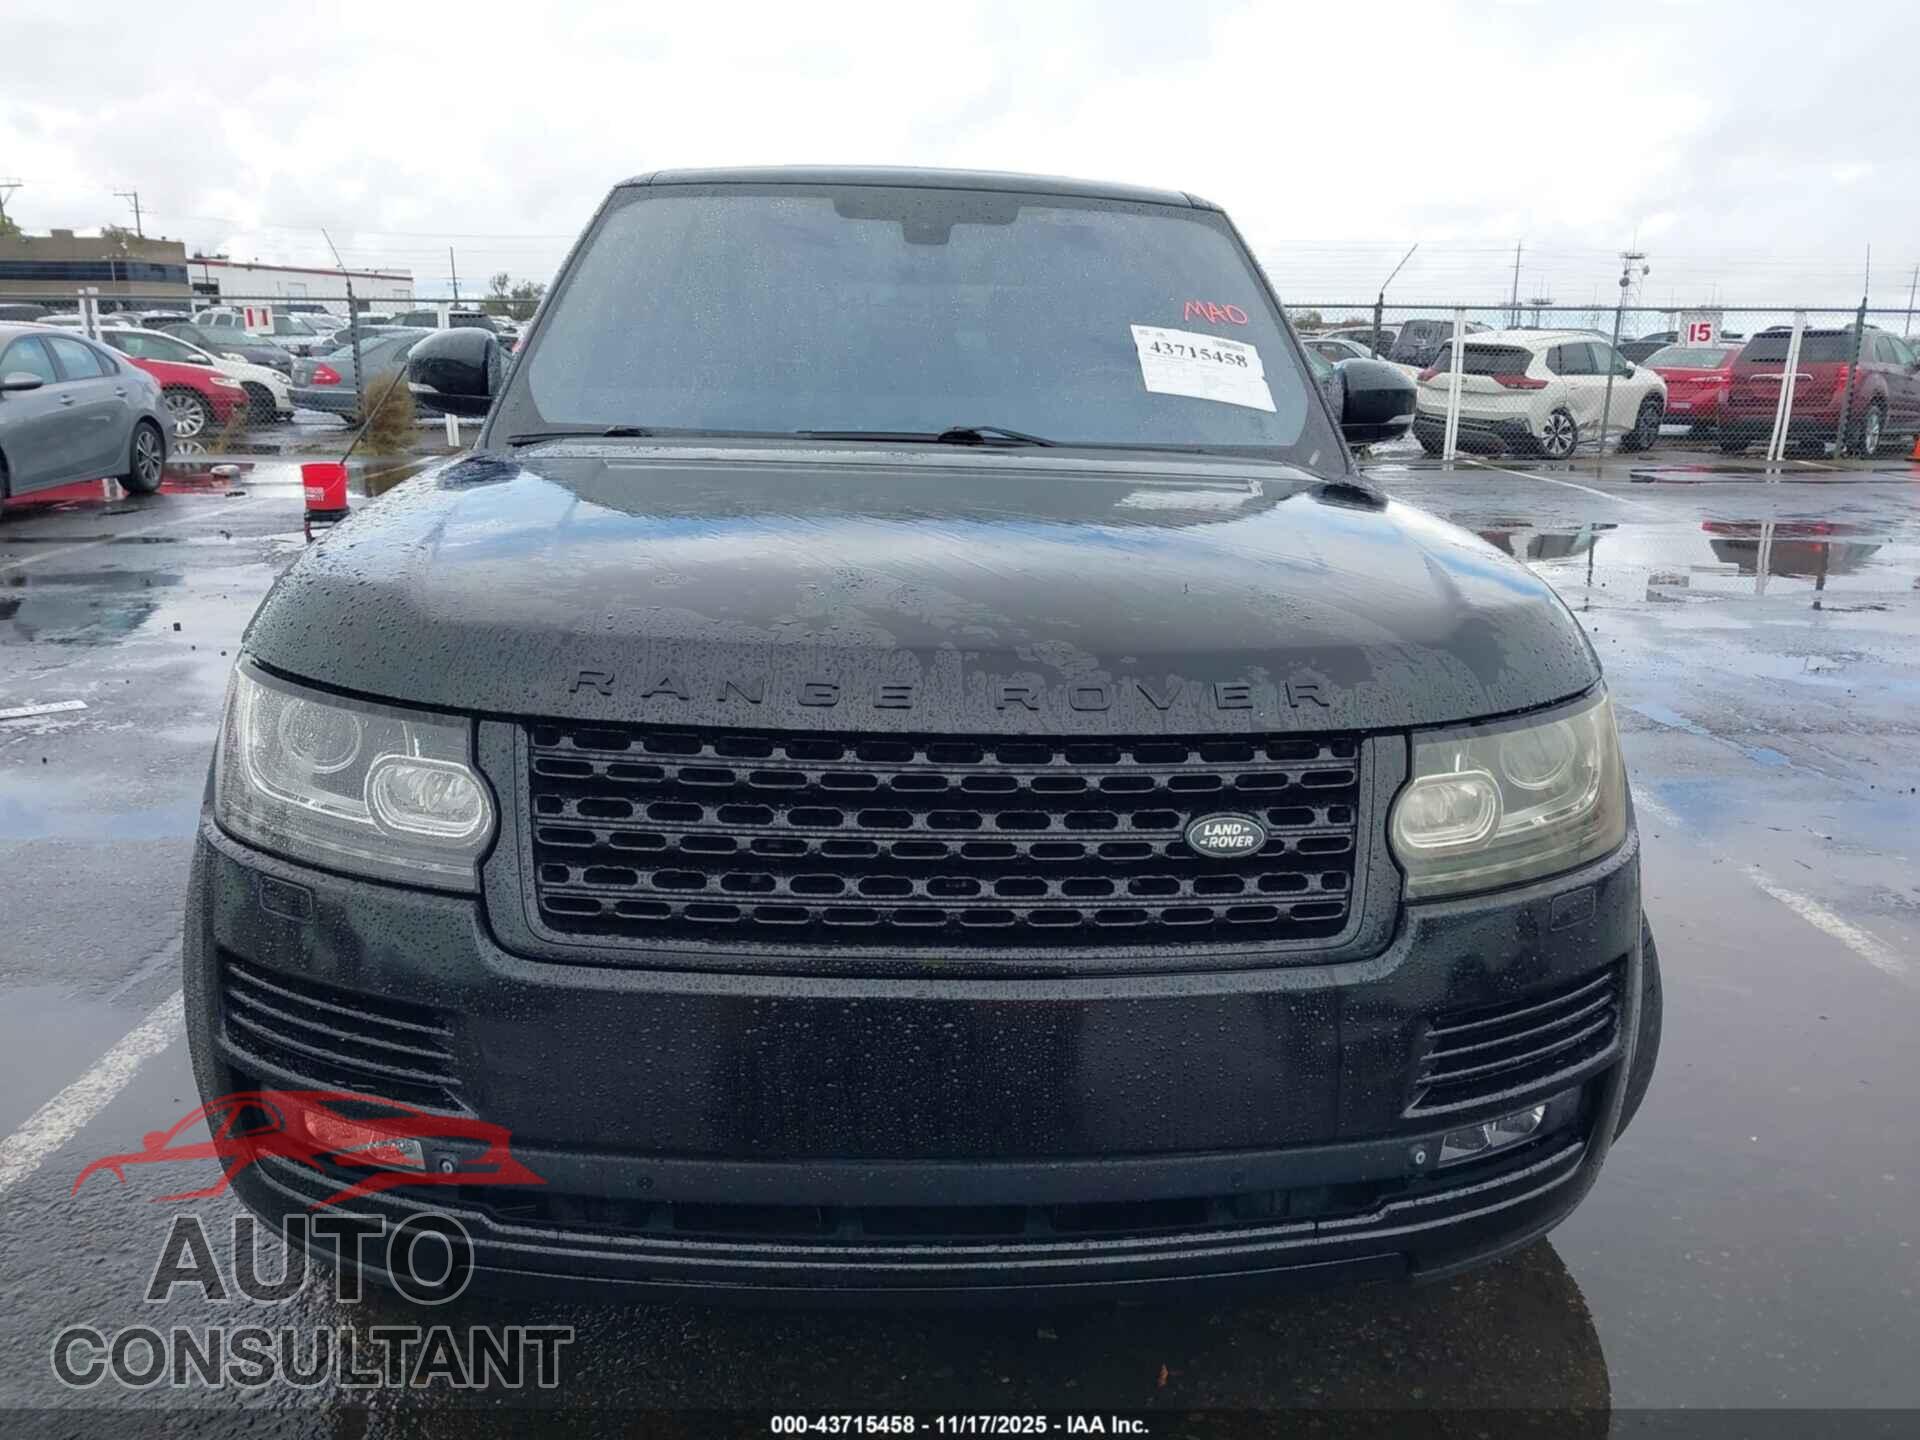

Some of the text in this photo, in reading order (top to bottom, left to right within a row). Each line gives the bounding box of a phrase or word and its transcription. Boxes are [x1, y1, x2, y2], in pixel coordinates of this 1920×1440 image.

[1690, 323, 1711, 342] 15
[1150, 341, 1248, 368] 43715458
[569, 671, 1330, 711] RANGE ROVER
